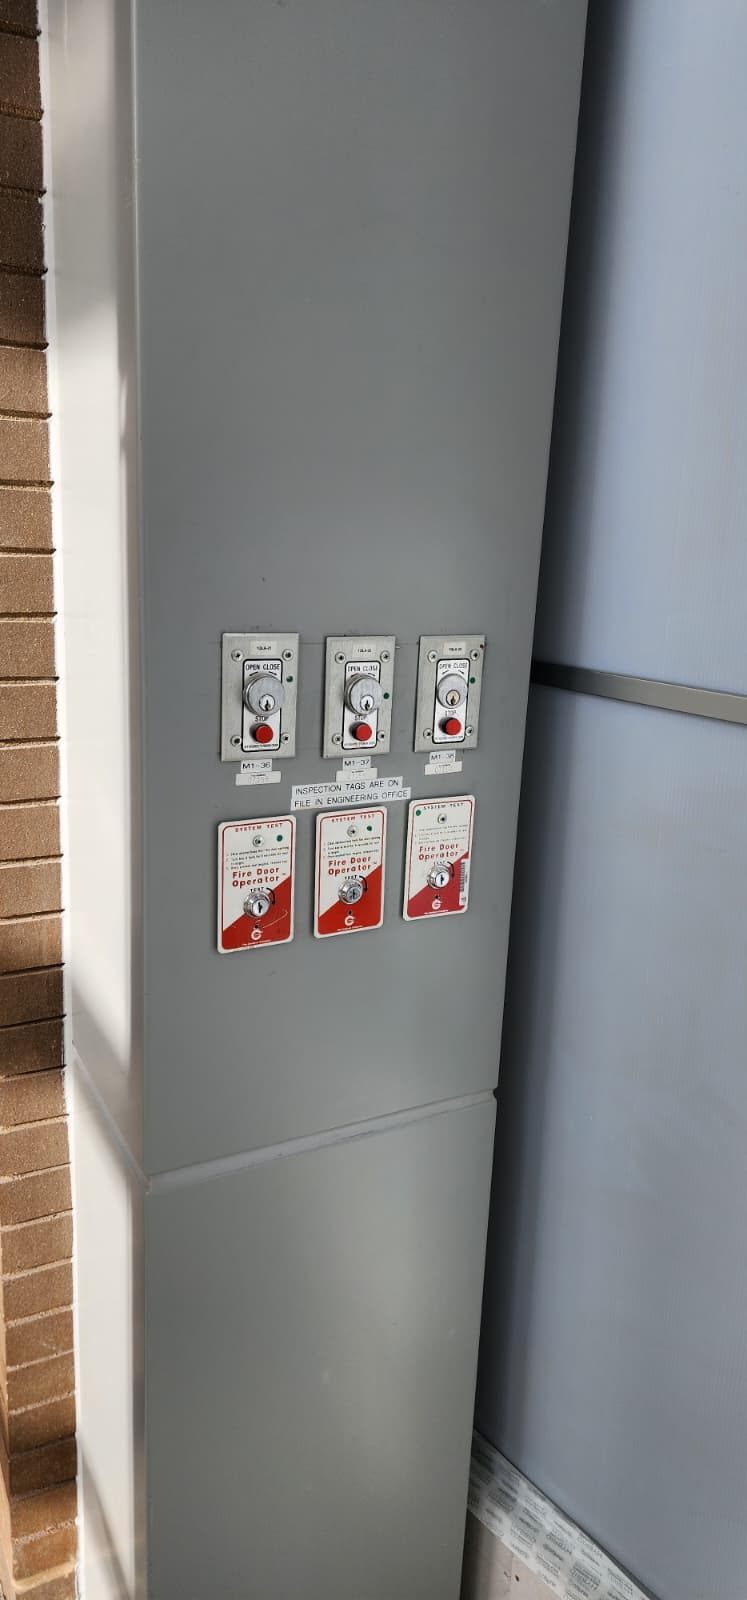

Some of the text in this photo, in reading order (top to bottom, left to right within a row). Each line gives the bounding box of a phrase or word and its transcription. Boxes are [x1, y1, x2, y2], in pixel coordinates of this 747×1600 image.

[242, 761, 271, 769] M1-36
[295, 779, 399, 795] INSPECTION TAGS ARE ON
[294, 789, 408, 808] FILE IN ENGINEERING OFFICE
[440, 843, 459, 851] Door
[418, 852, 458, 863] Operator
[256, 867, 280, 875] Door
[328, 865, 371, 877] Operator
[232, 875, 280, 889] Operator
